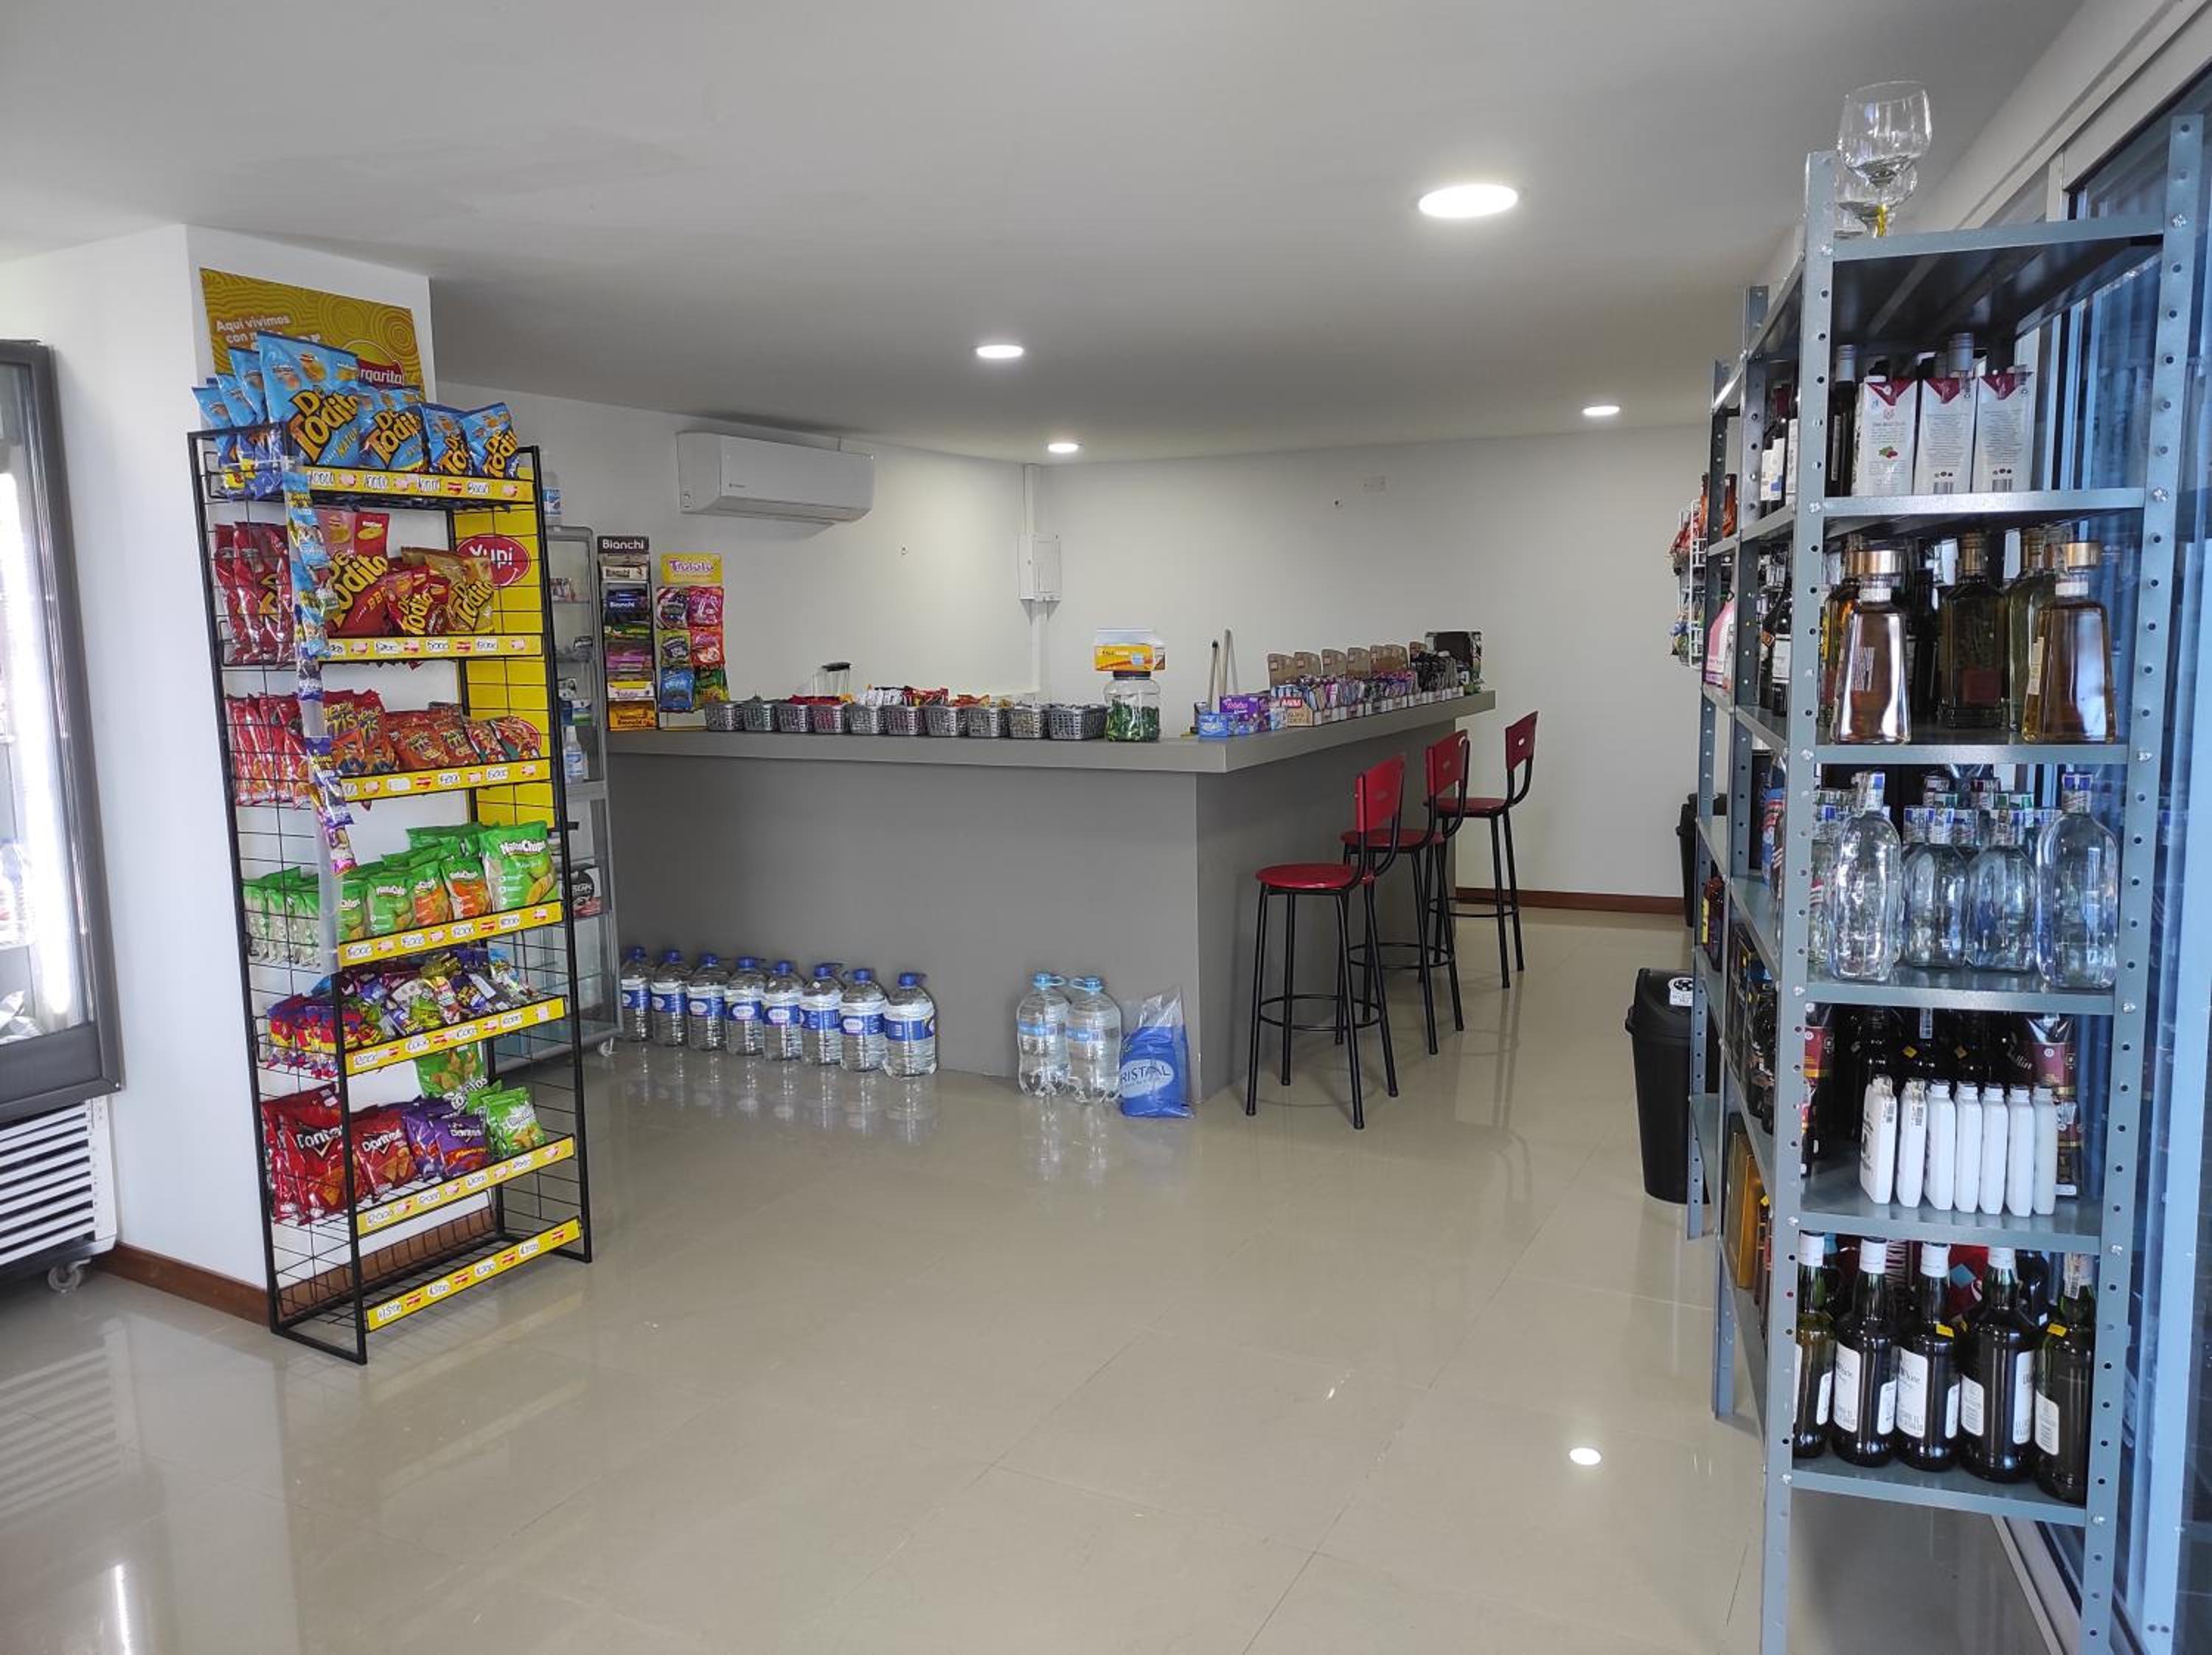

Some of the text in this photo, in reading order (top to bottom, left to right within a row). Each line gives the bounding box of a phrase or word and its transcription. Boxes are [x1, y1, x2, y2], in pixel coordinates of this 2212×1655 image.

[246, 315, 290, 327] vivimos
[360, 367, 403, 384] rgarita
[602, 538, 644, 549] Bianchi
[1120, 1065, 1171, 1086] RISTAL
[361, 1128, 403, 1152] Doritos
